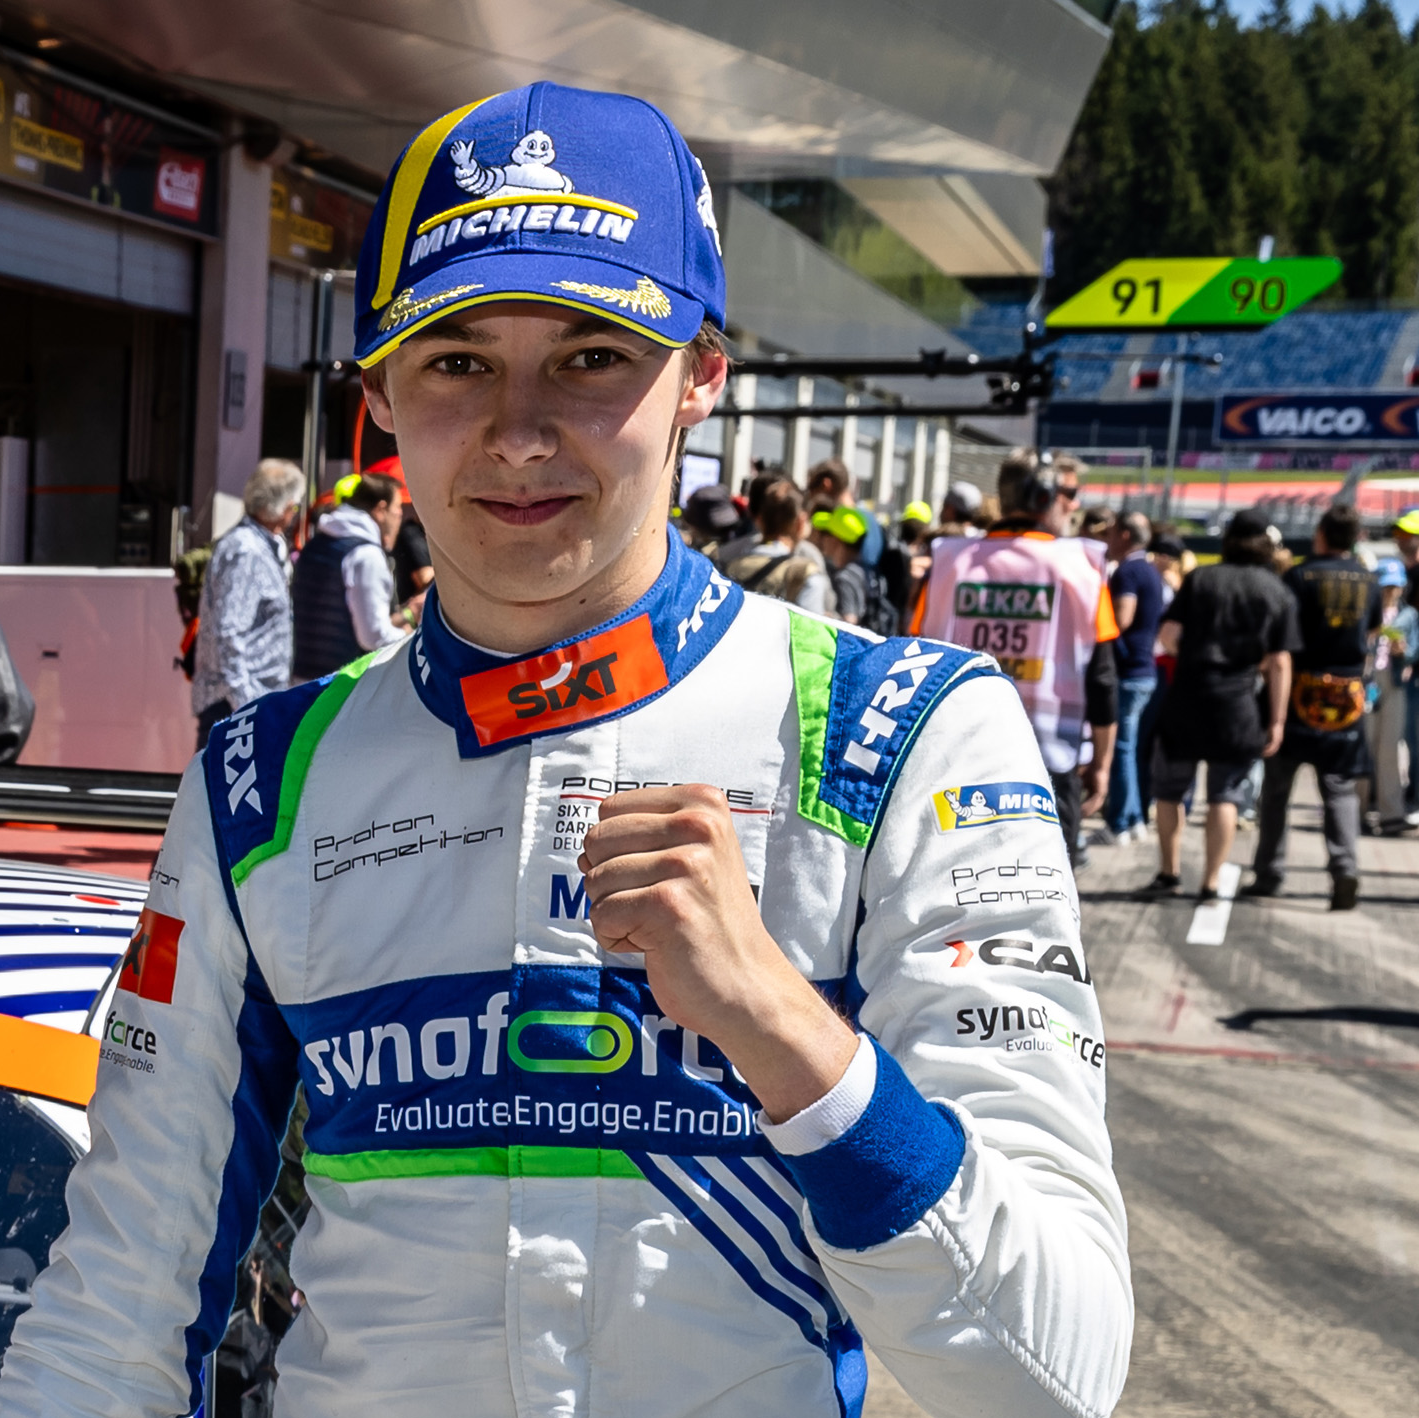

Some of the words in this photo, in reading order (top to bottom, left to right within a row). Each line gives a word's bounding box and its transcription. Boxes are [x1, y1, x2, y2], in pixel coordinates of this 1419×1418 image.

[409, 204, 637, 266] MICHELIN
[1113, 278, 1163, 317] 91
[1230, 277, 1288, 316] 90
[1257, 407, 1366, 436] VAICO
[957, 588, 1051, 616] DEKRA
[973, 623, 1028, 653] 035
[844, 640, 945, 775] HRX
[224, 704, 263, 816] HRX
[557, 804, 592, 819] SIXT
[314, 814, 434, 857] Proton
[314, 826, 504, 883] Competition
